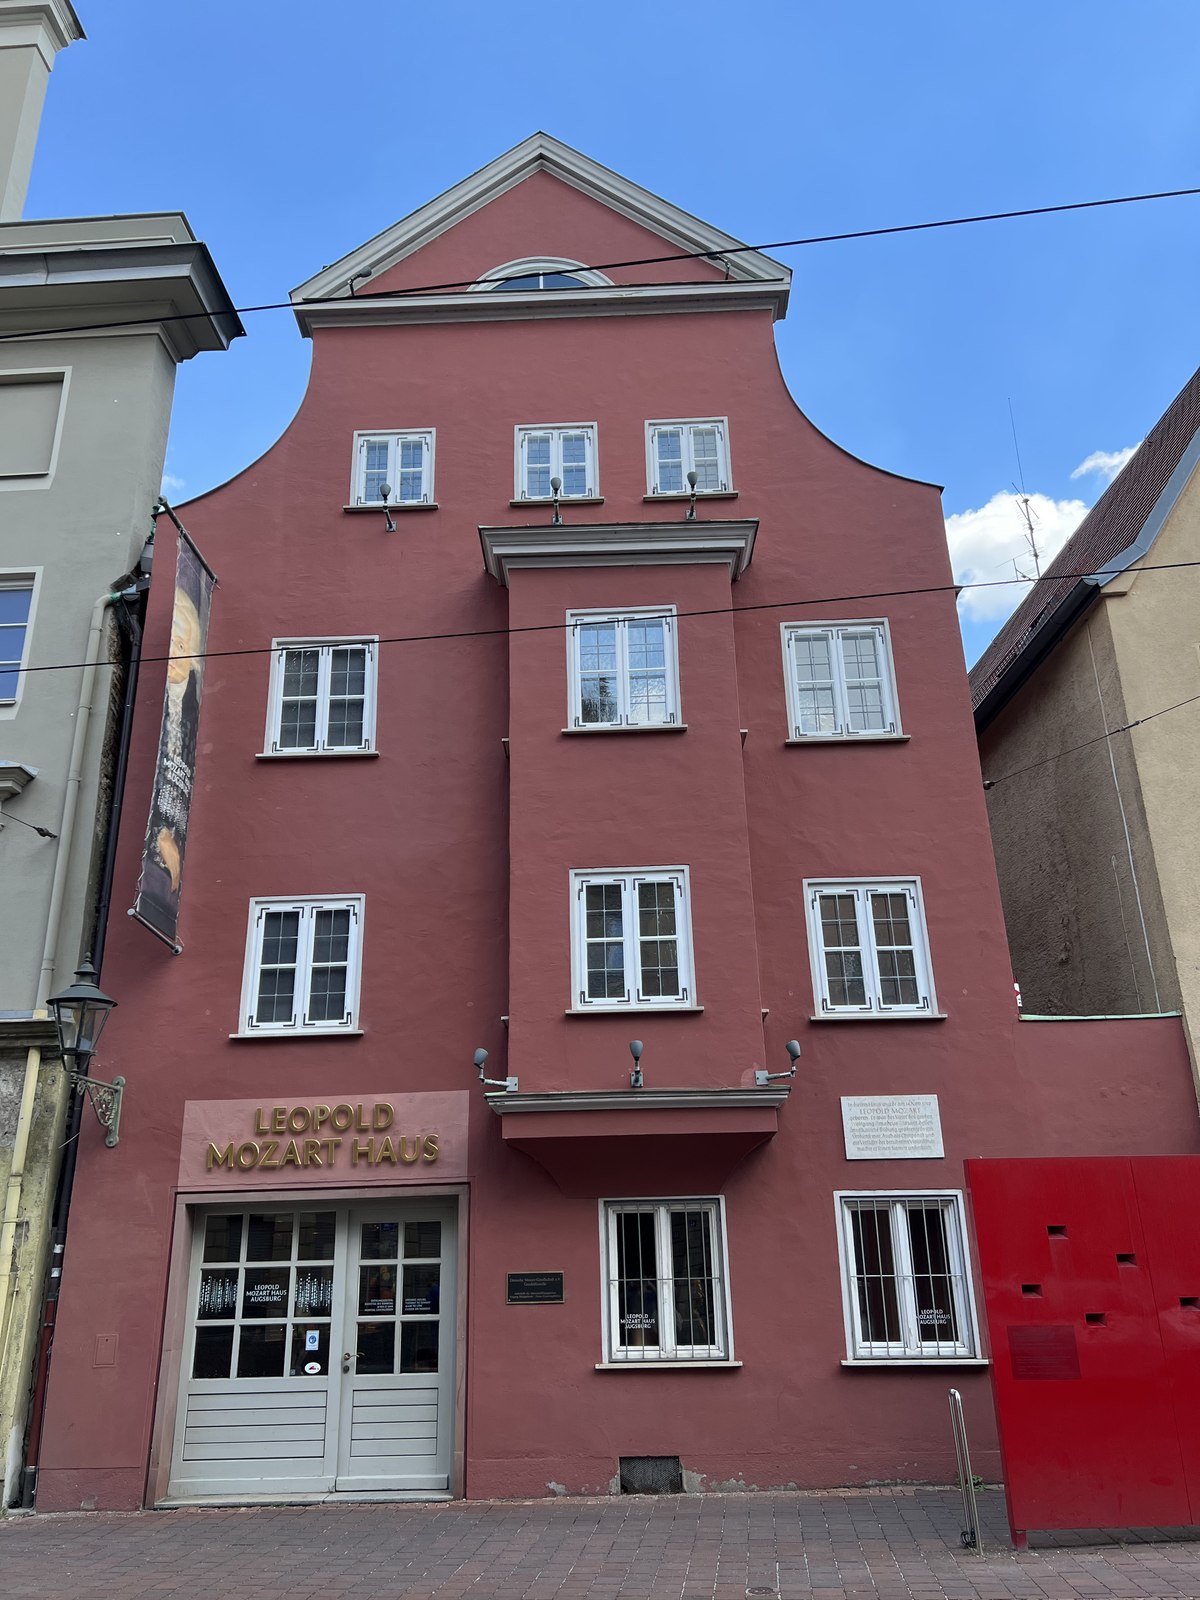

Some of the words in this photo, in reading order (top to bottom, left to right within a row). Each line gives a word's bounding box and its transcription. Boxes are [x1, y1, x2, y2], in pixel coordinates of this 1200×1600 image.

[255, 1103, 395, 1133] LEOPOLD
[207, 1138, 342, 1169] MOZART
[352, 1134, 439, 1164] HAUS
